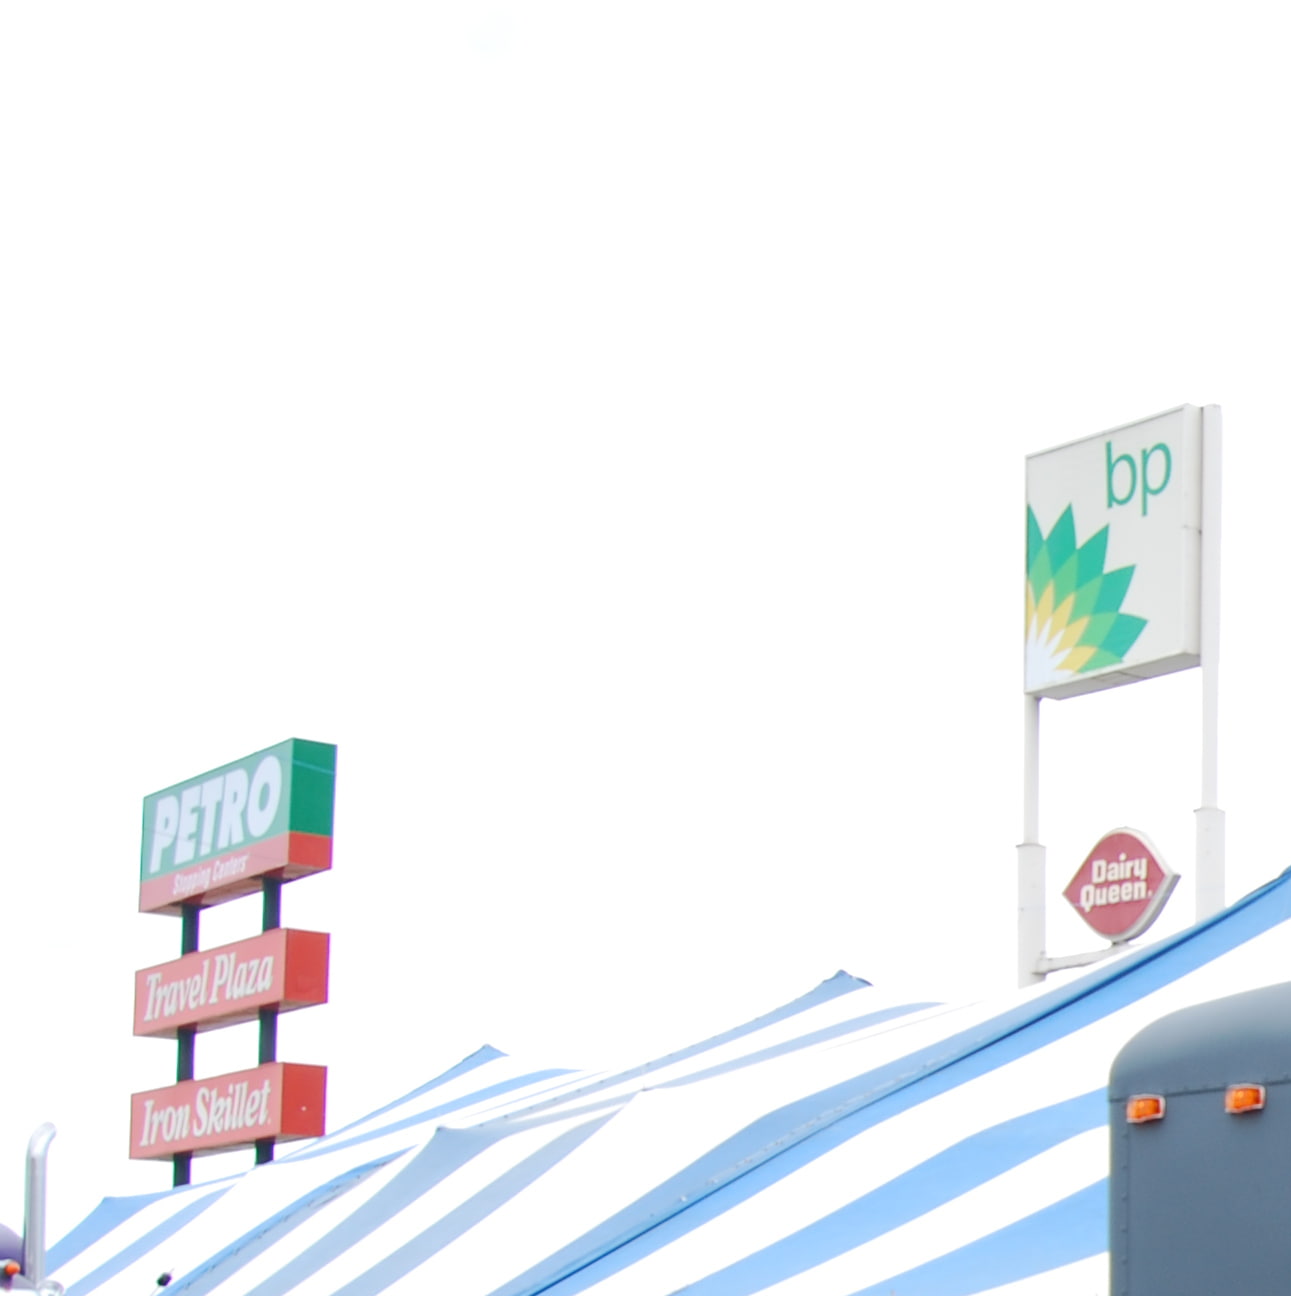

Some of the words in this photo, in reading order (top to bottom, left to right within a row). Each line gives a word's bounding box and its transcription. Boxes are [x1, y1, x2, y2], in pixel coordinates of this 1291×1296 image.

[1106, 440, 1173, 517] bp
[149, 754, 283, 876] PETRO
[1091, 852, 1147, 884] Dairy
[143, 955, 207, 1022] Travel
[208, 952, 274, 1006] Plaza
[140, 1098, 189, 1147] Iron
[193, 1079, 271, 1138] Skillet
